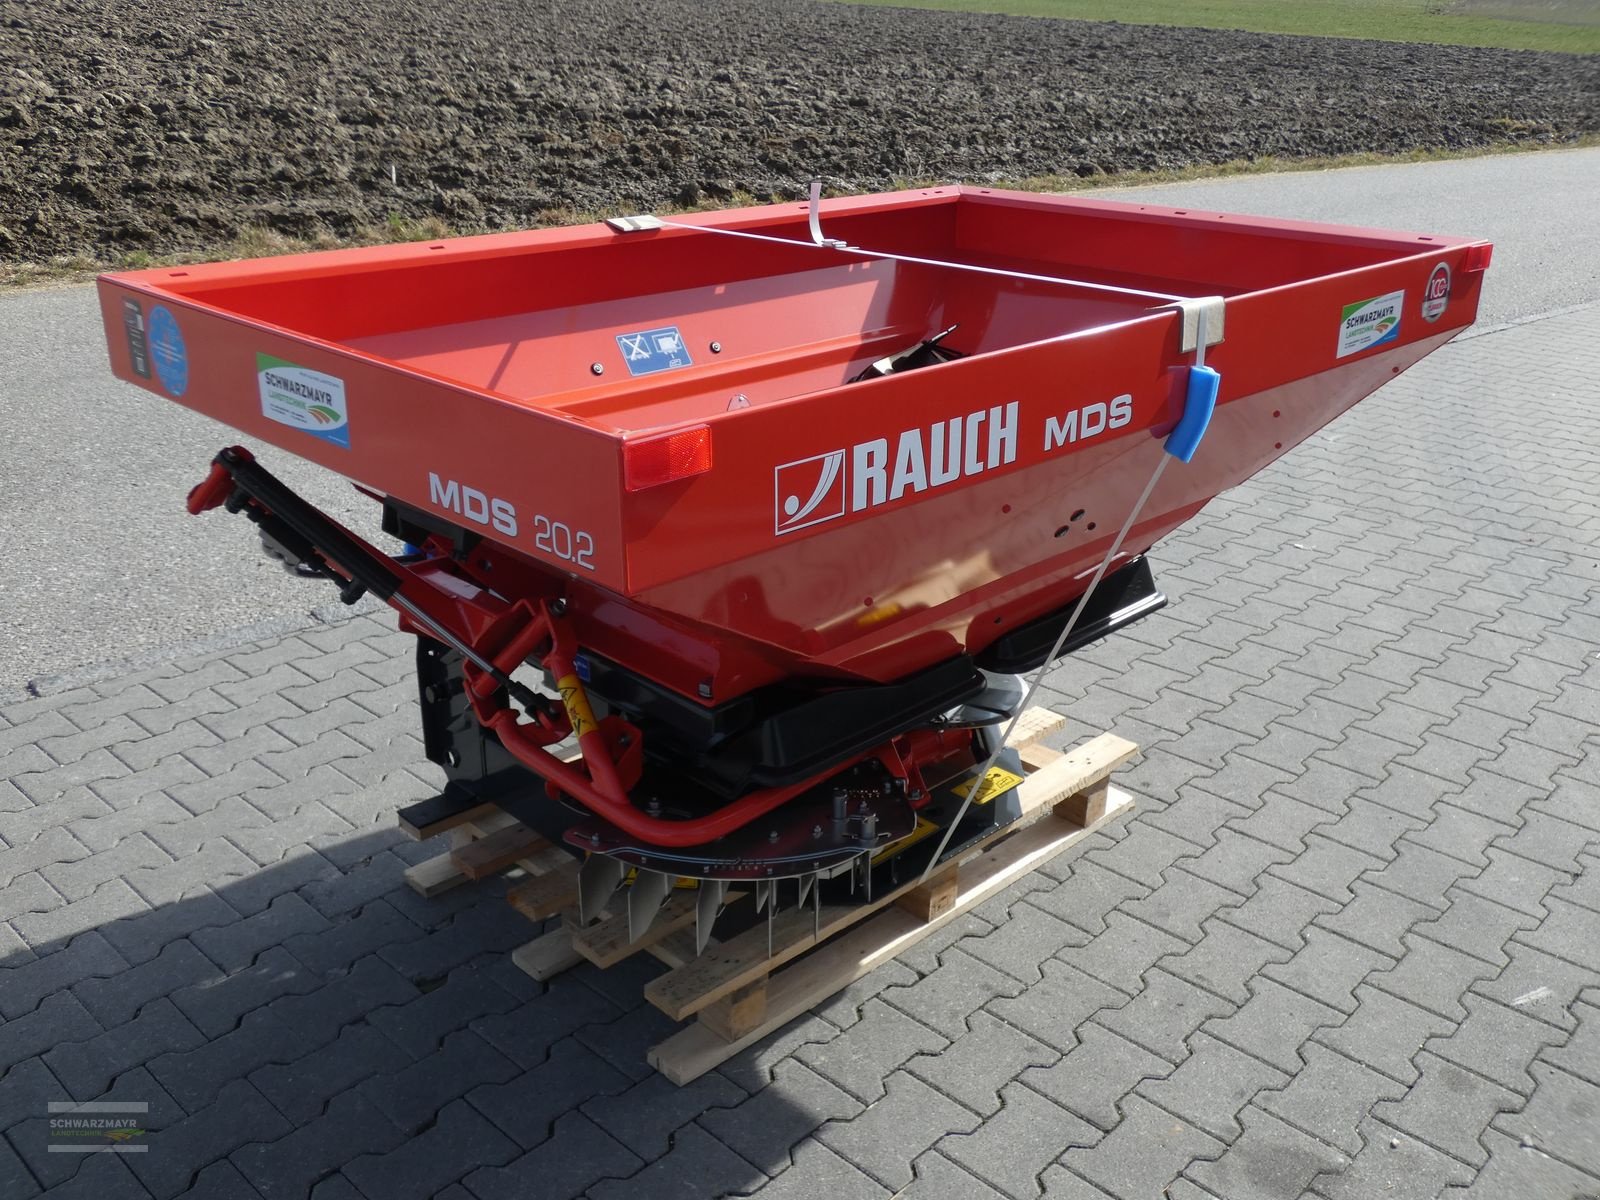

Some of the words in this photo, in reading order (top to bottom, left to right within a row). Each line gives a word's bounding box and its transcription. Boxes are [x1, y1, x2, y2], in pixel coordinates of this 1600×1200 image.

[1345, 305, 1394, 330] SCHWARZMAYR
[264, 371, 333, 406] SCHWARZMAYR
[852, 400, 1019, 512] RAUCH
[1044, 393, 1133, 451] MDS
[428, 471, 518, 537] MDS
[534, 514, 595, 570] 20.2
